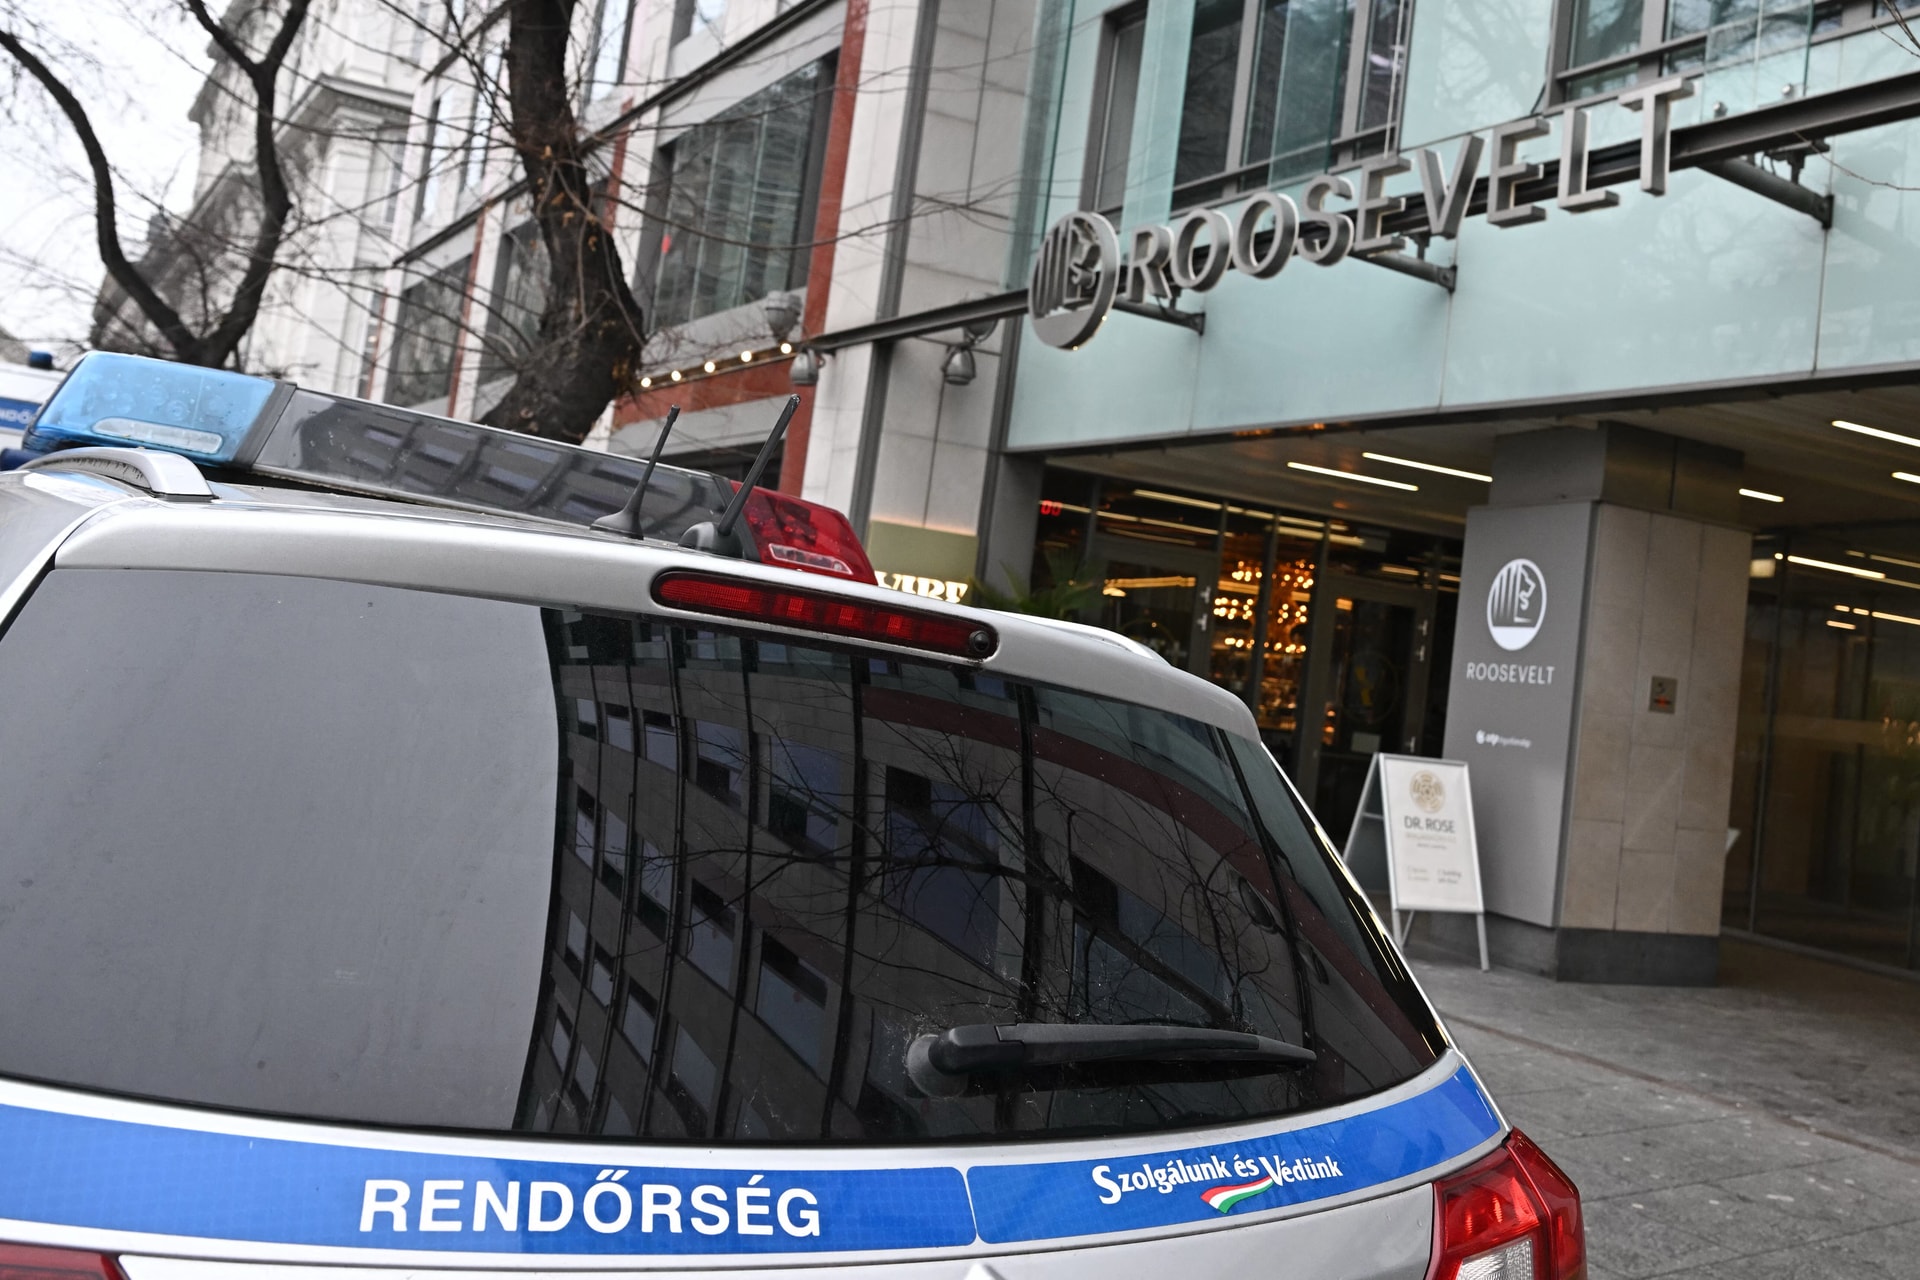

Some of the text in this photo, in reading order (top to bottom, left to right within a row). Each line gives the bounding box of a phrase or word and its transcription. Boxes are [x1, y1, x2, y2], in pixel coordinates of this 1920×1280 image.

[1125, 77, 1696, 300] ROOSEVELT
[1466, 661, 1555, 685] ROOSEVELT
[1404, 815, 1456, 834] DR. ROSE
[359, 1169, 821, 1238] RENDŐRSÉG
[1092, 1153, 1344, 1205] Szolgálunk és Védünk
